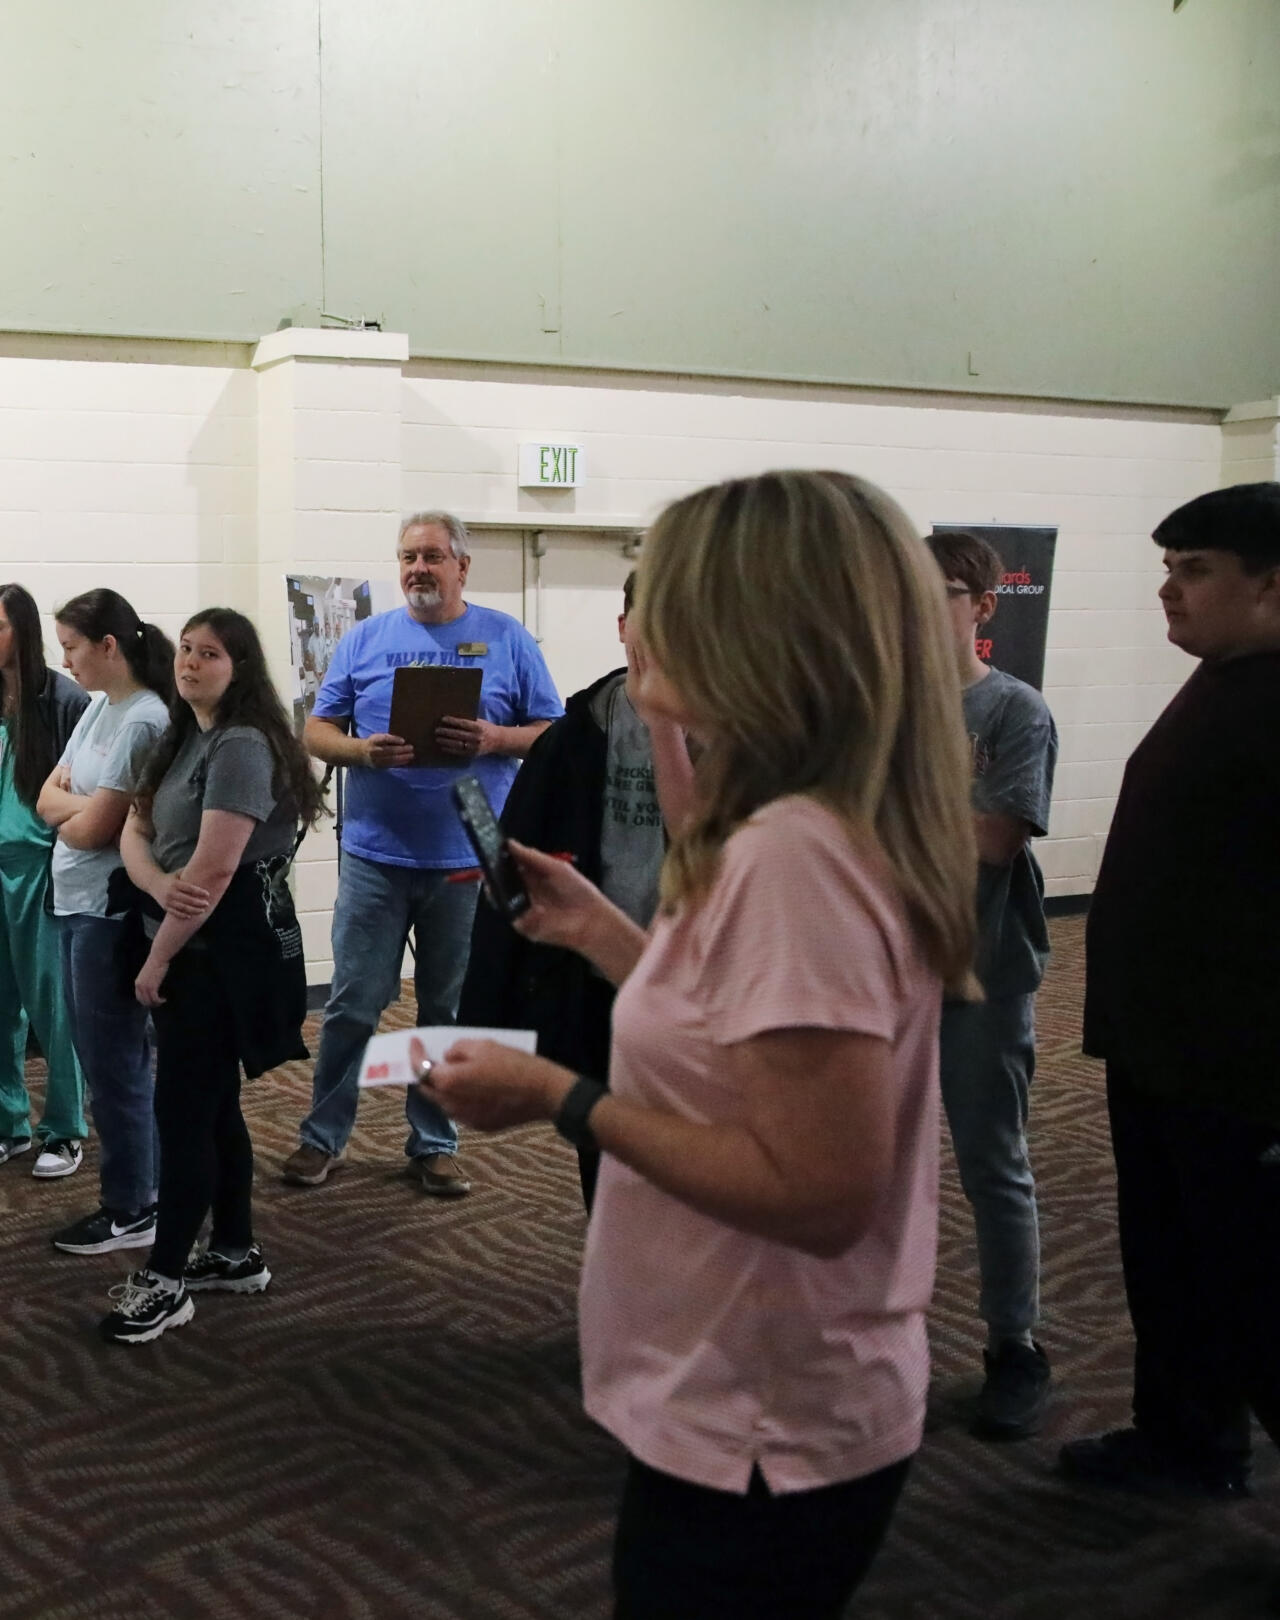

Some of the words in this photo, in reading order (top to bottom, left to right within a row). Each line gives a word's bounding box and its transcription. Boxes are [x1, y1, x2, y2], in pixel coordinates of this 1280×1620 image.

[540, 447, 577, 482] EXIT
[995, 584, 1015, 594] DICAL
[1017, 584, 1045, 594] GROUP
